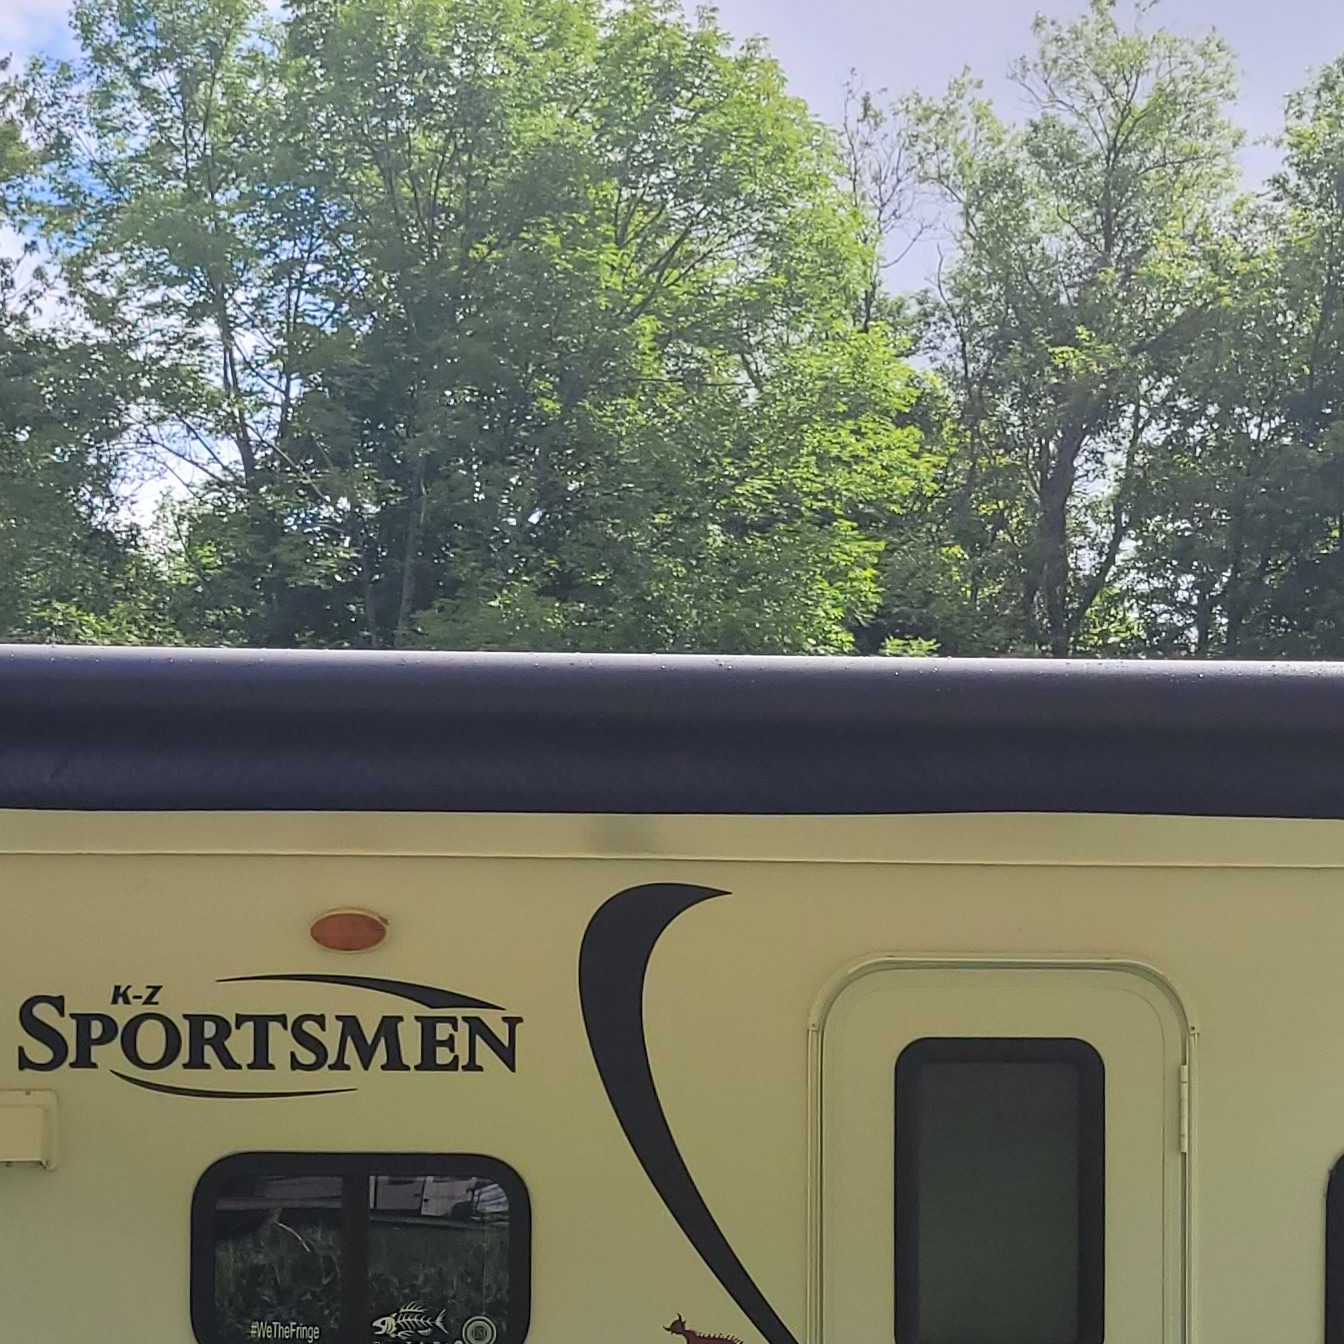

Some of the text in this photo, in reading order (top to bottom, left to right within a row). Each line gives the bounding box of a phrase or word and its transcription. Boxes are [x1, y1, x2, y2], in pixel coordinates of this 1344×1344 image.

[110, 984, 163, 1005] K-Z
[17, 995, 524, 1074] SPORTSMEN
[250, 1321, 320, 1344] #WeTheFringe
